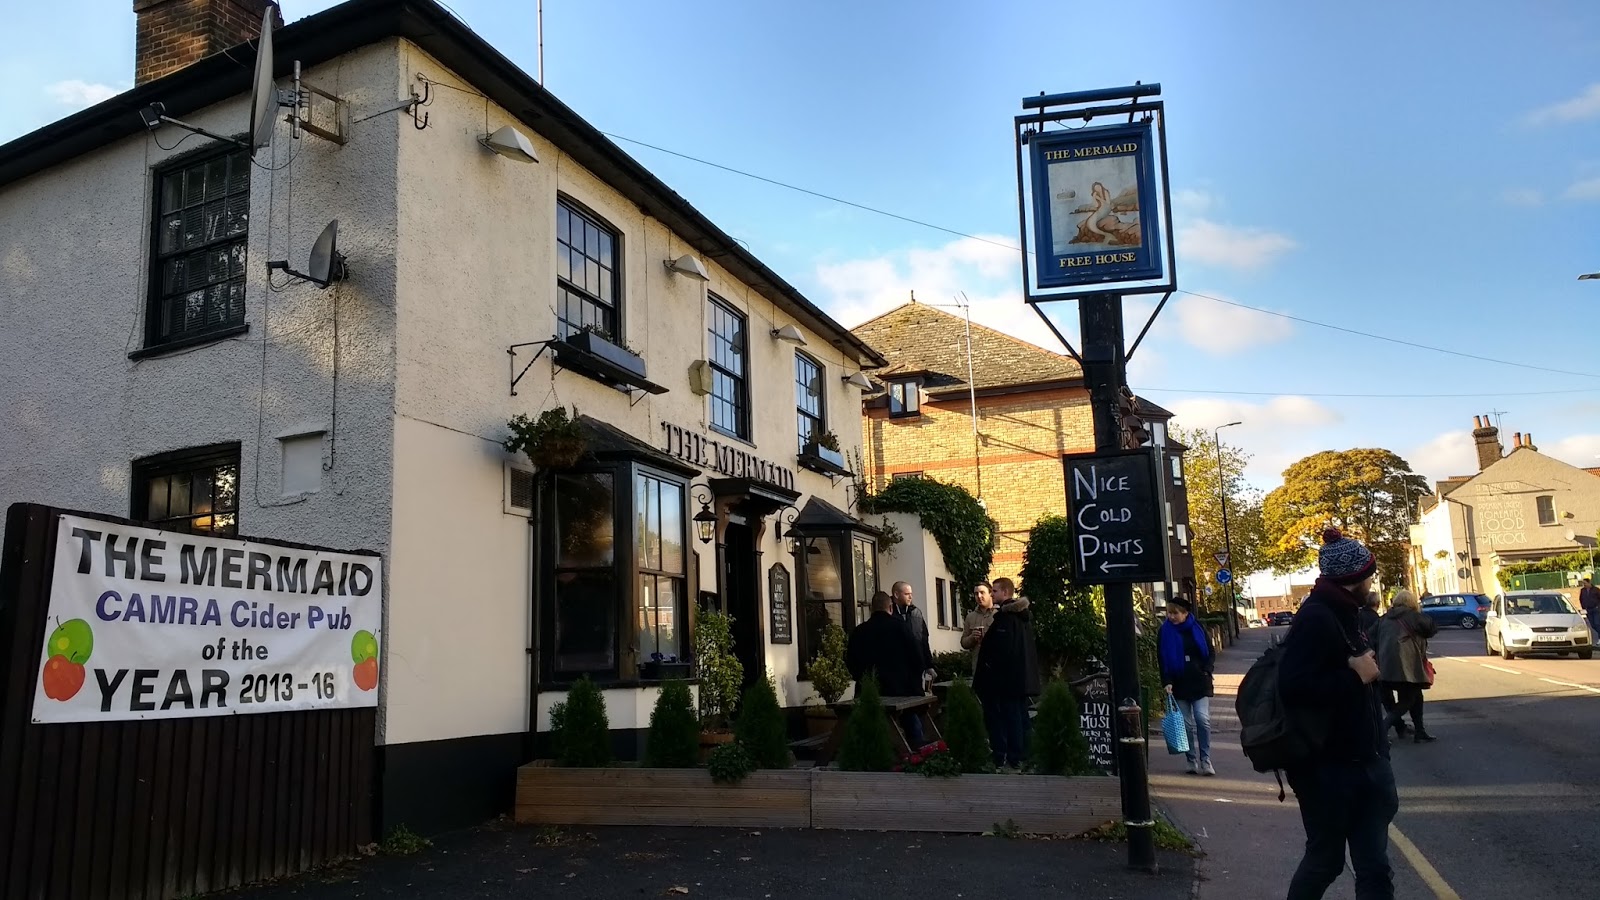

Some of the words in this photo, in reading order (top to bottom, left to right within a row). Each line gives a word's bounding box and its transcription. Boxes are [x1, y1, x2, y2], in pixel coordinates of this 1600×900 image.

[1044, 149, 1071, 161] THE
[1073, 142, 1138, 158] MERMAID
[1059, 255, 1092, 268] FREE
[1095, 252, 1136, 265] HOUSE
[661, 421, 715, 470] THE
[714, 440, 794, 491] MERMAID
[1480, 517, 1525, 532] FOOD
[71, 527, 168, 583] THE
[179, 544, 374, 597] MERMAID
[95, 590, 222, 627] CAMRA
[230, 600, 301, 630] Cider
[307, 605, 352, 630] Pub
[201, 638, 226, 661] of
[231, 638, 269, 660] the
[94, 668, 231, 713] YEAR
[239, 671, 336, 705] 2013-16
